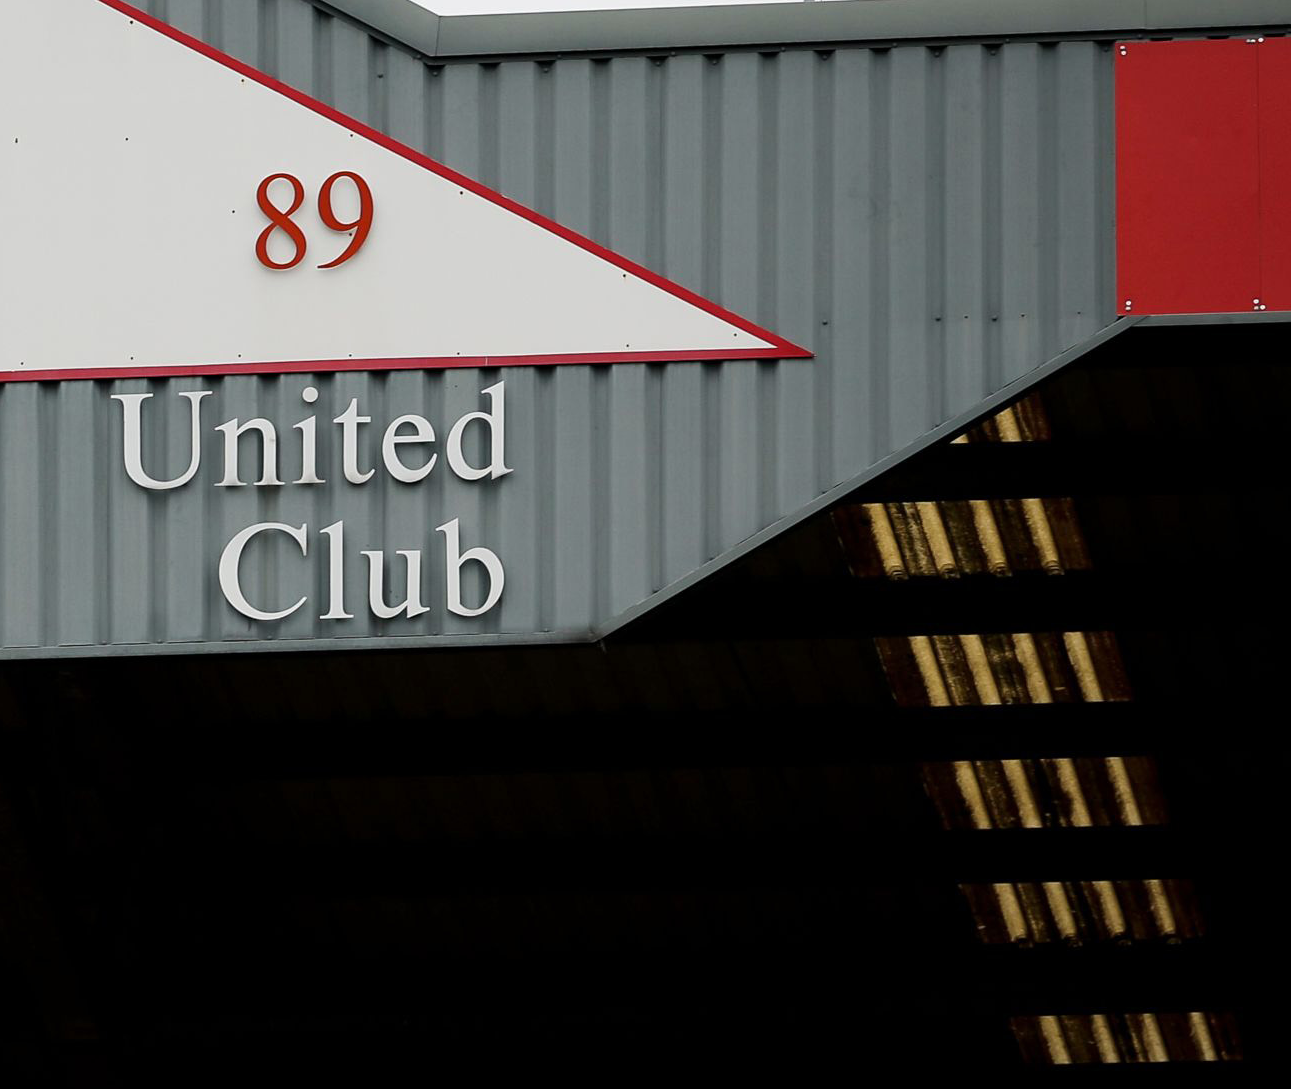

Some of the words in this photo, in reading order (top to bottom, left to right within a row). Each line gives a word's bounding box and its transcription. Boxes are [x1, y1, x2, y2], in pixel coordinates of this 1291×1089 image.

[255, 171, 374, 270] 89
[110, 380, 515, 491] United
[218, 517, 506, 621] Club
